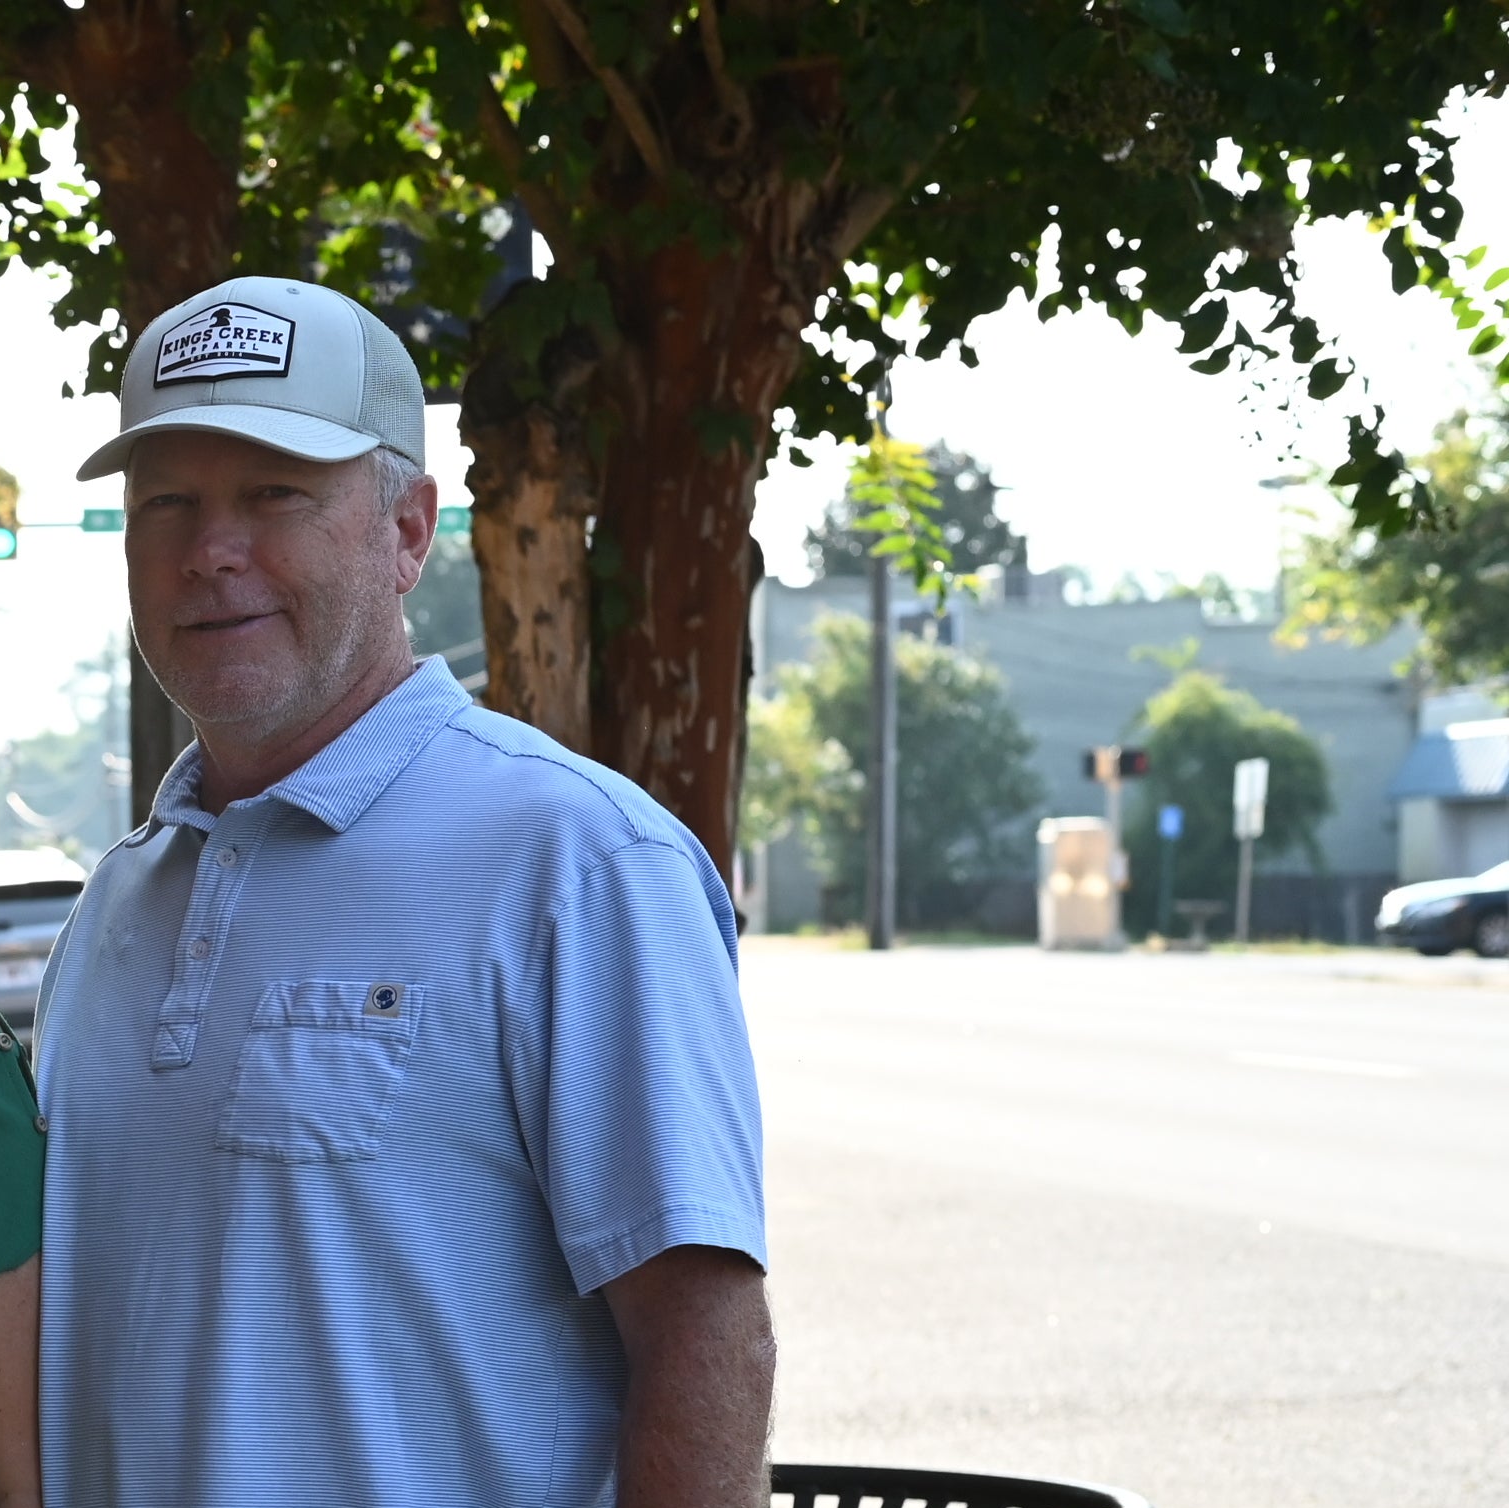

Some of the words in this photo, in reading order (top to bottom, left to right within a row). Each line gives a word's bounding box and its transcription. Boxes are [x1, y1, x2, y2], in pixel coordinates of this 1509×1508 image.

[163, 329, 213, 356] KINGS
[219, 327, 284, 345] CREEK
[180, 341, 259, 358] APPAREL
